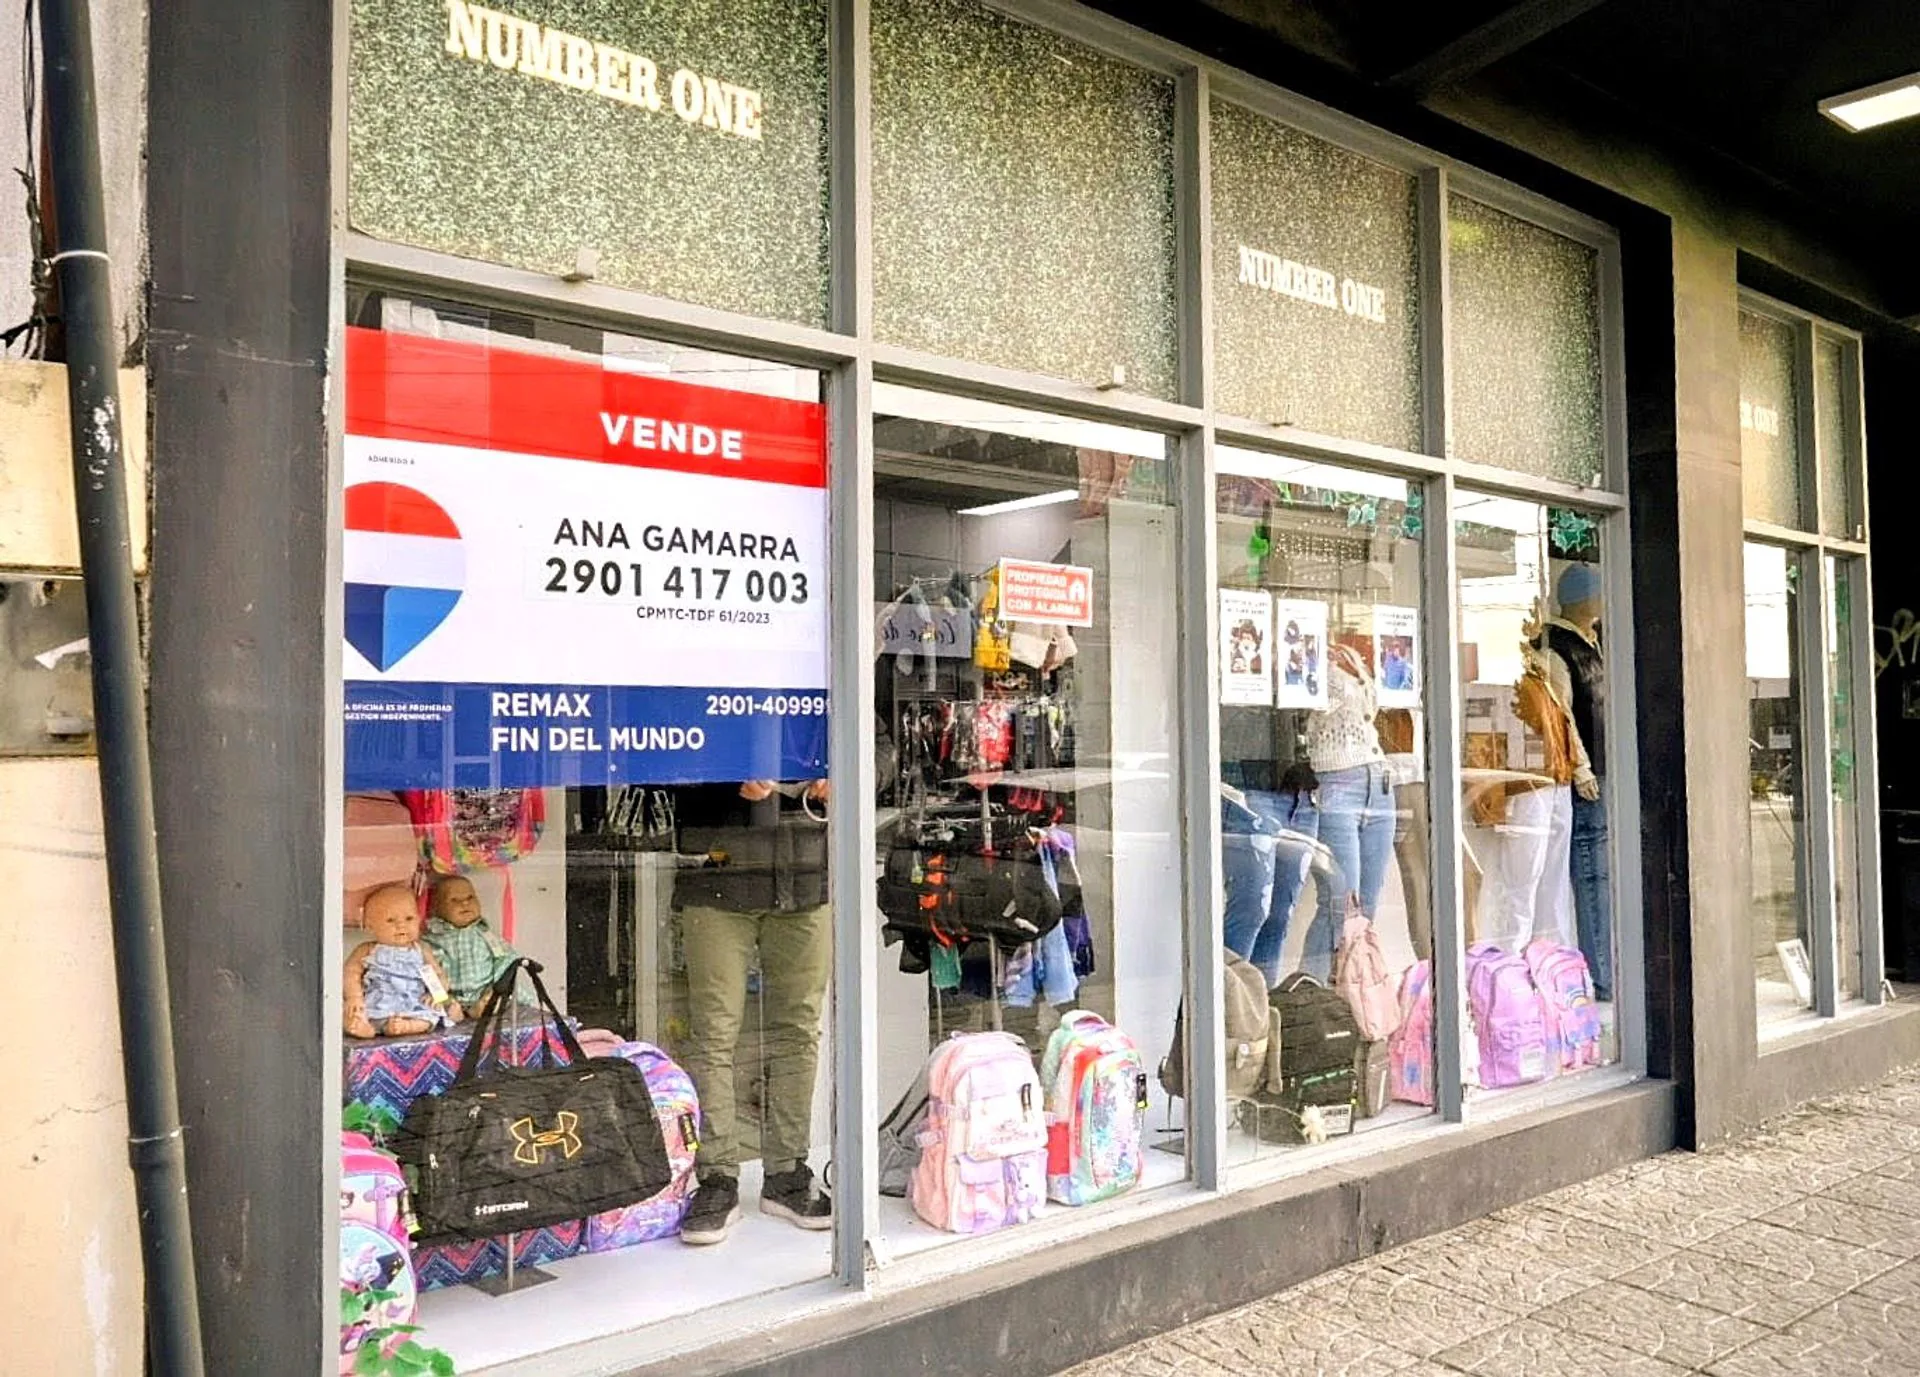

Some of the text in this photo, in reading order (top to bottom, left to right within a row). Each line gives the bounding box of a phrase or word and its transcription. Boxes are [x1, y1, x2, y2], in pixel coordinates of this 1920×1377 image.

[446, 0, 763, 140] NUMBER ONE
[1239, 247, 1386, 323] NUMBER ONE
[600, 412, 744, 460] VENDE
[553, 518, 800, 563] ANA GAMARRA
[545, 557, 808, 604] 2901 417 003
[636, 606, 770, 624] CPMTC-TDF 61/2023
[1007, 598, 1032, 611] CON
[492, 692, 591, 717] REMAX
[492, 727, 705, 752] FIN DEL MUNDO
